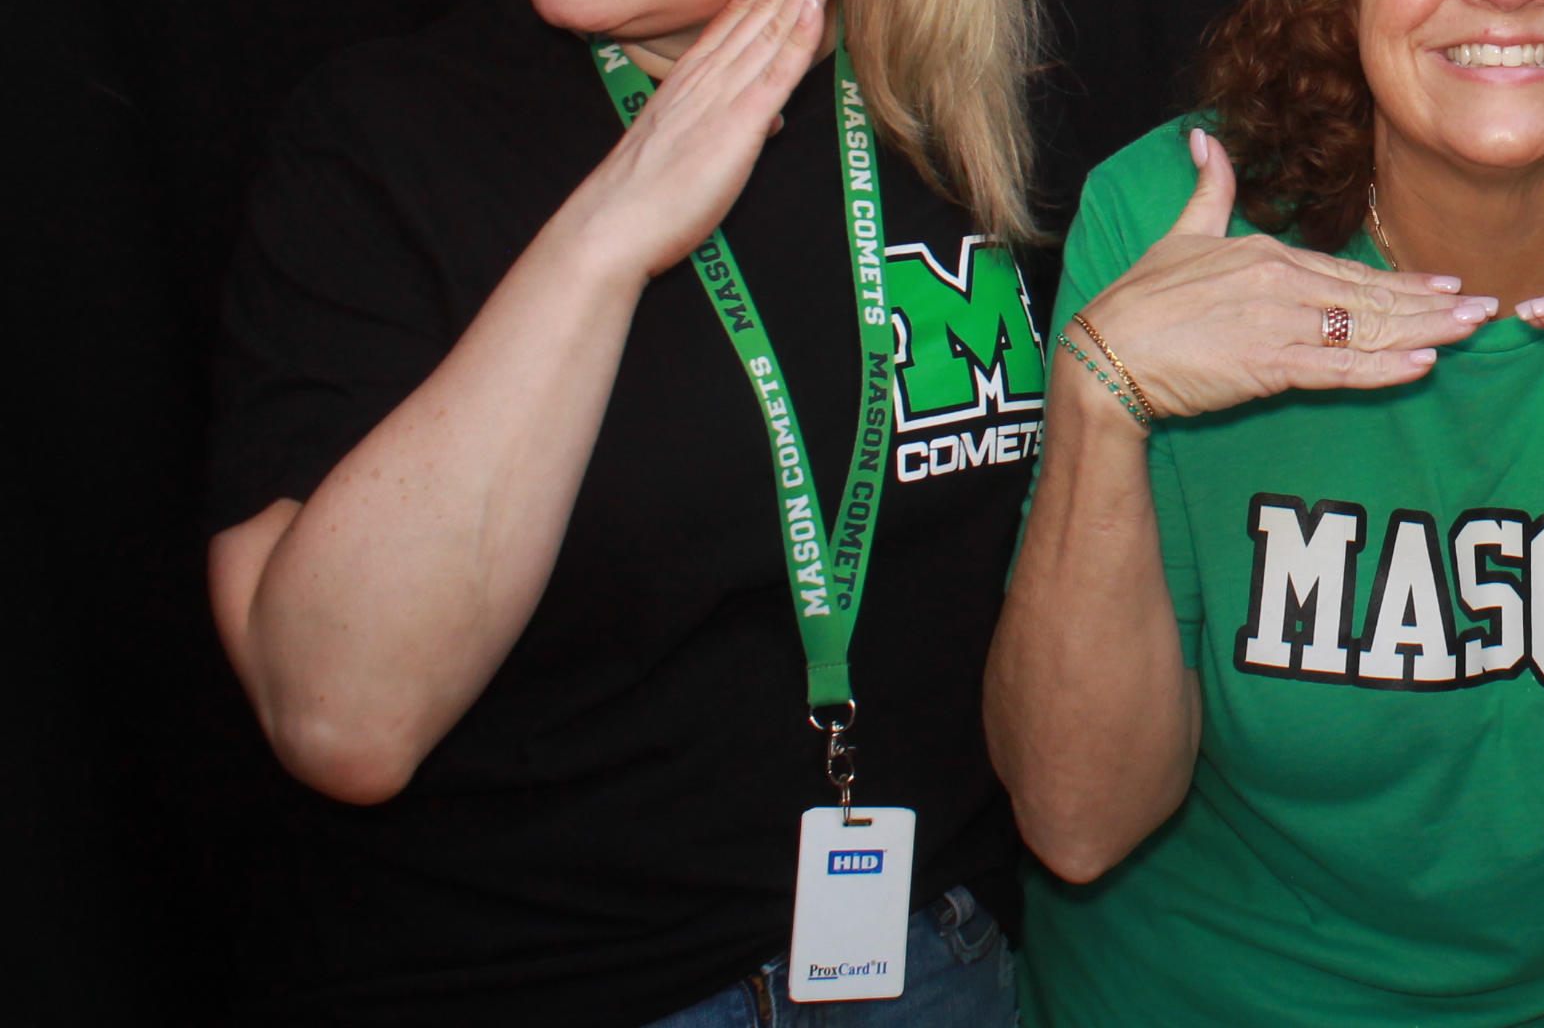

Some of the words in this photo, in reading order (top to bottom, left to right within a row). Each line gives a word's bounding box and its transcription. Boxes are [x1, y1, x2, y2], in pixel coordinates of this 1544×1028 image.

[841, 79, 874, 192] MASON
[695, 235, 755, 334] MASO
[852, 199, 886, 326] COMETS
[885, 234, 1046, 433] M
[749, 355, 805, 489] COMETS
[858, 351, 889, 472] MASON
[785, 494, 831, 618] MASON
[833, 854, 878, 870] HID
